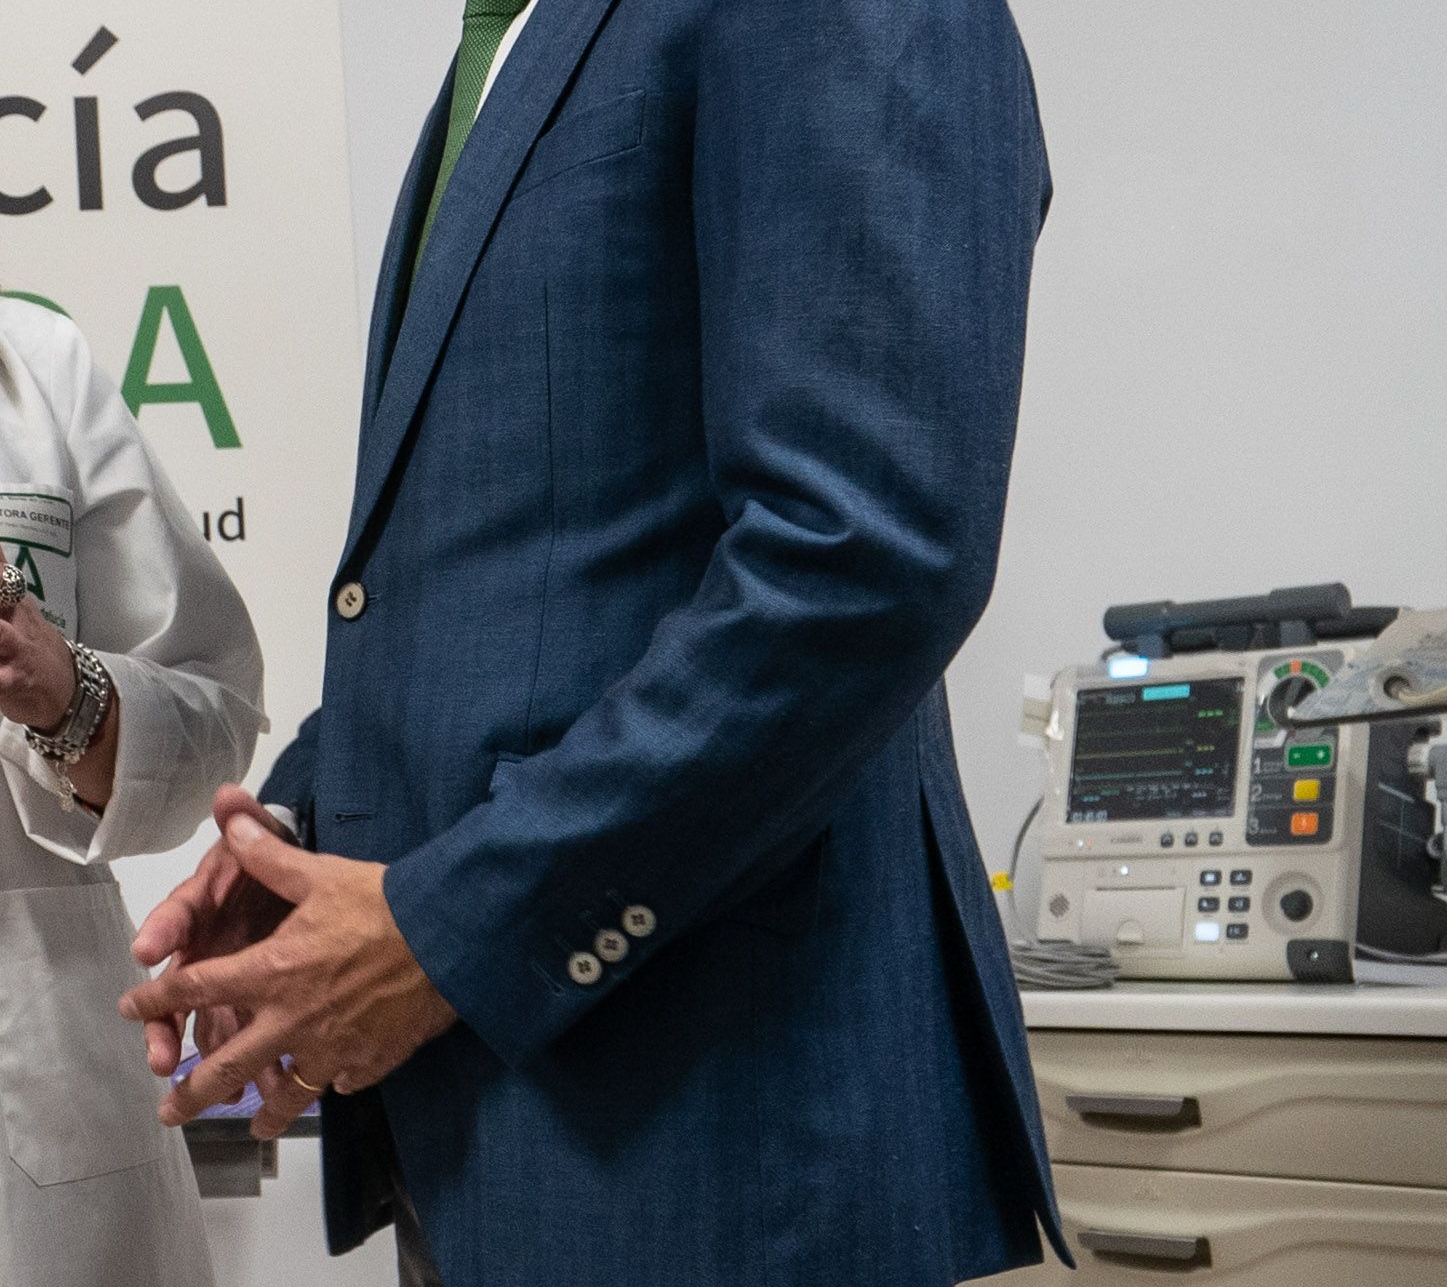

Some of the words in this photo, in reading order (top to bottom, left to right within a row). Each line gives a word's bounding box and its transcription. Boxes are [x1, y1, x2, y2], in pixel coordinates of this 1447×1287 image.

[29, 511, 70, 530] GERENTE
[1253, 757, 1261, 774] 1
[1250, 784, 1262, 802] 2
